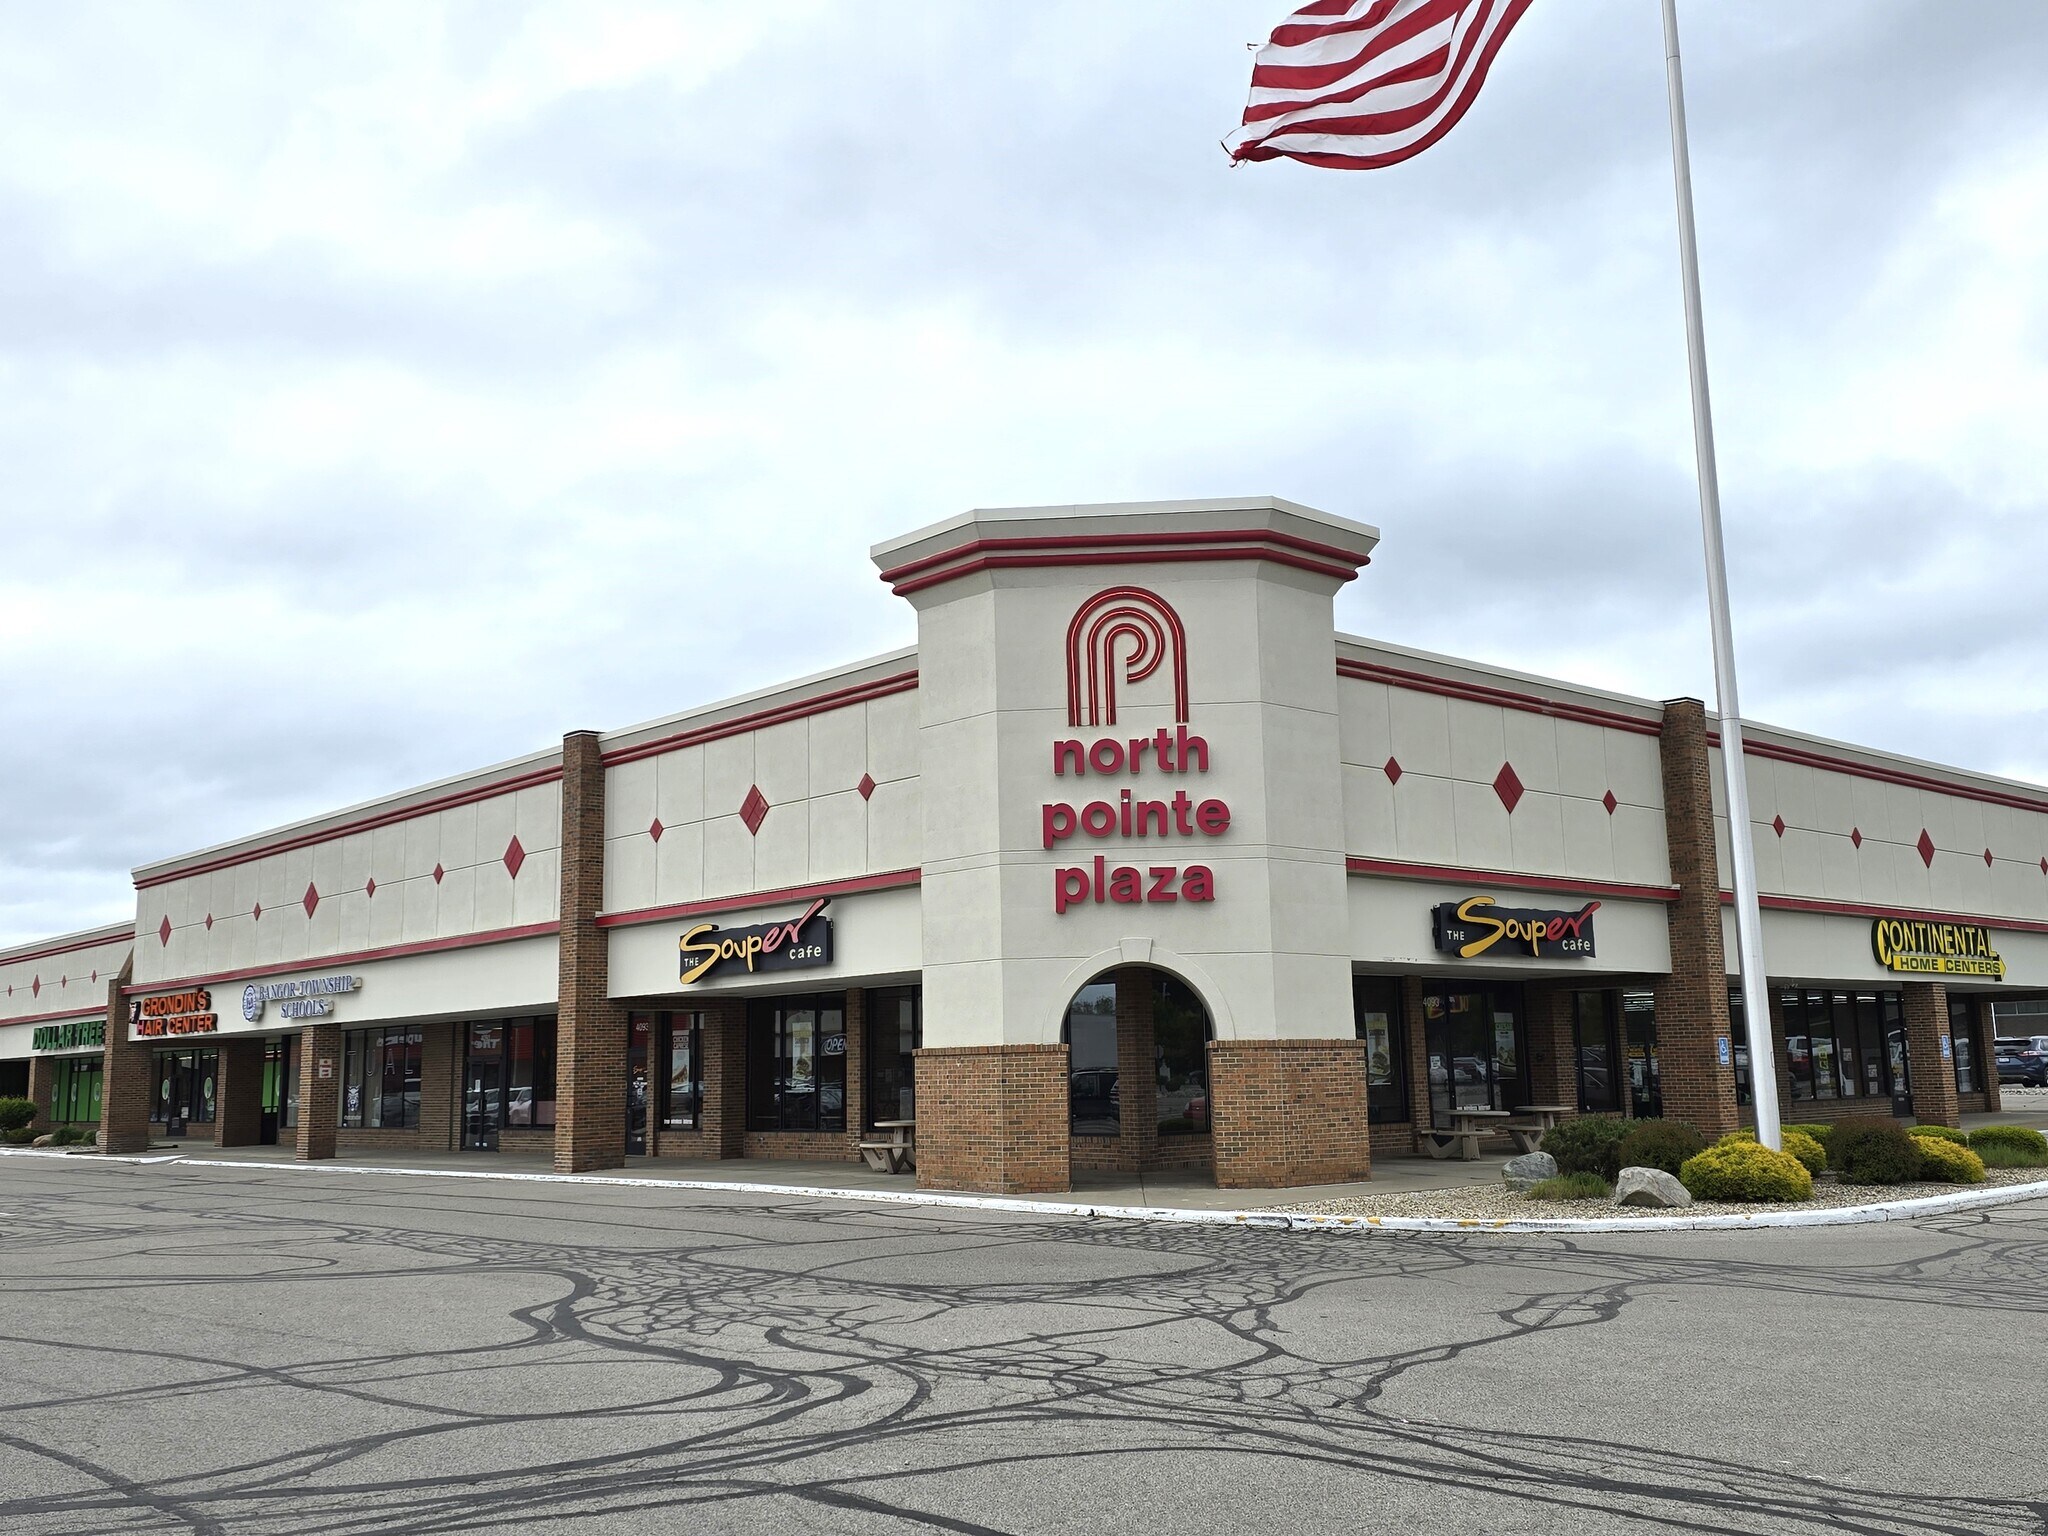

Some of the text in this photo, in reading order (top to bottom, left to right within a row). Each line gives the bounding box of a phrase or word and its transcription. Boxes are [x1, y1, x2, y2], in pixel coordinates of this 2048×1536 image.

[1054, 725, 1209, 776] north
[1042, 789, 1231, 849] pointe
[1055, 855, 1216, 914] plaza
[680, 898, 831, 984] THE Souper cafe
[1447, 896, 1601, 958] THE Souper cafe
[1873, 919, 1997, 966] CONTINENTAL
[1900, 958, 2000, 975] HOME CENTERS
[142, 989, 209, 1016] GRONDIN'S
[259, 975, 353, 1001] BANGOR TOWNSHIP
[137, 1015, 214, 1036] HAIR CENTER
[281, 998, 325, 1018] SCHOOLS
[32, 1022, 103, 1050] DOLLAR TREE
